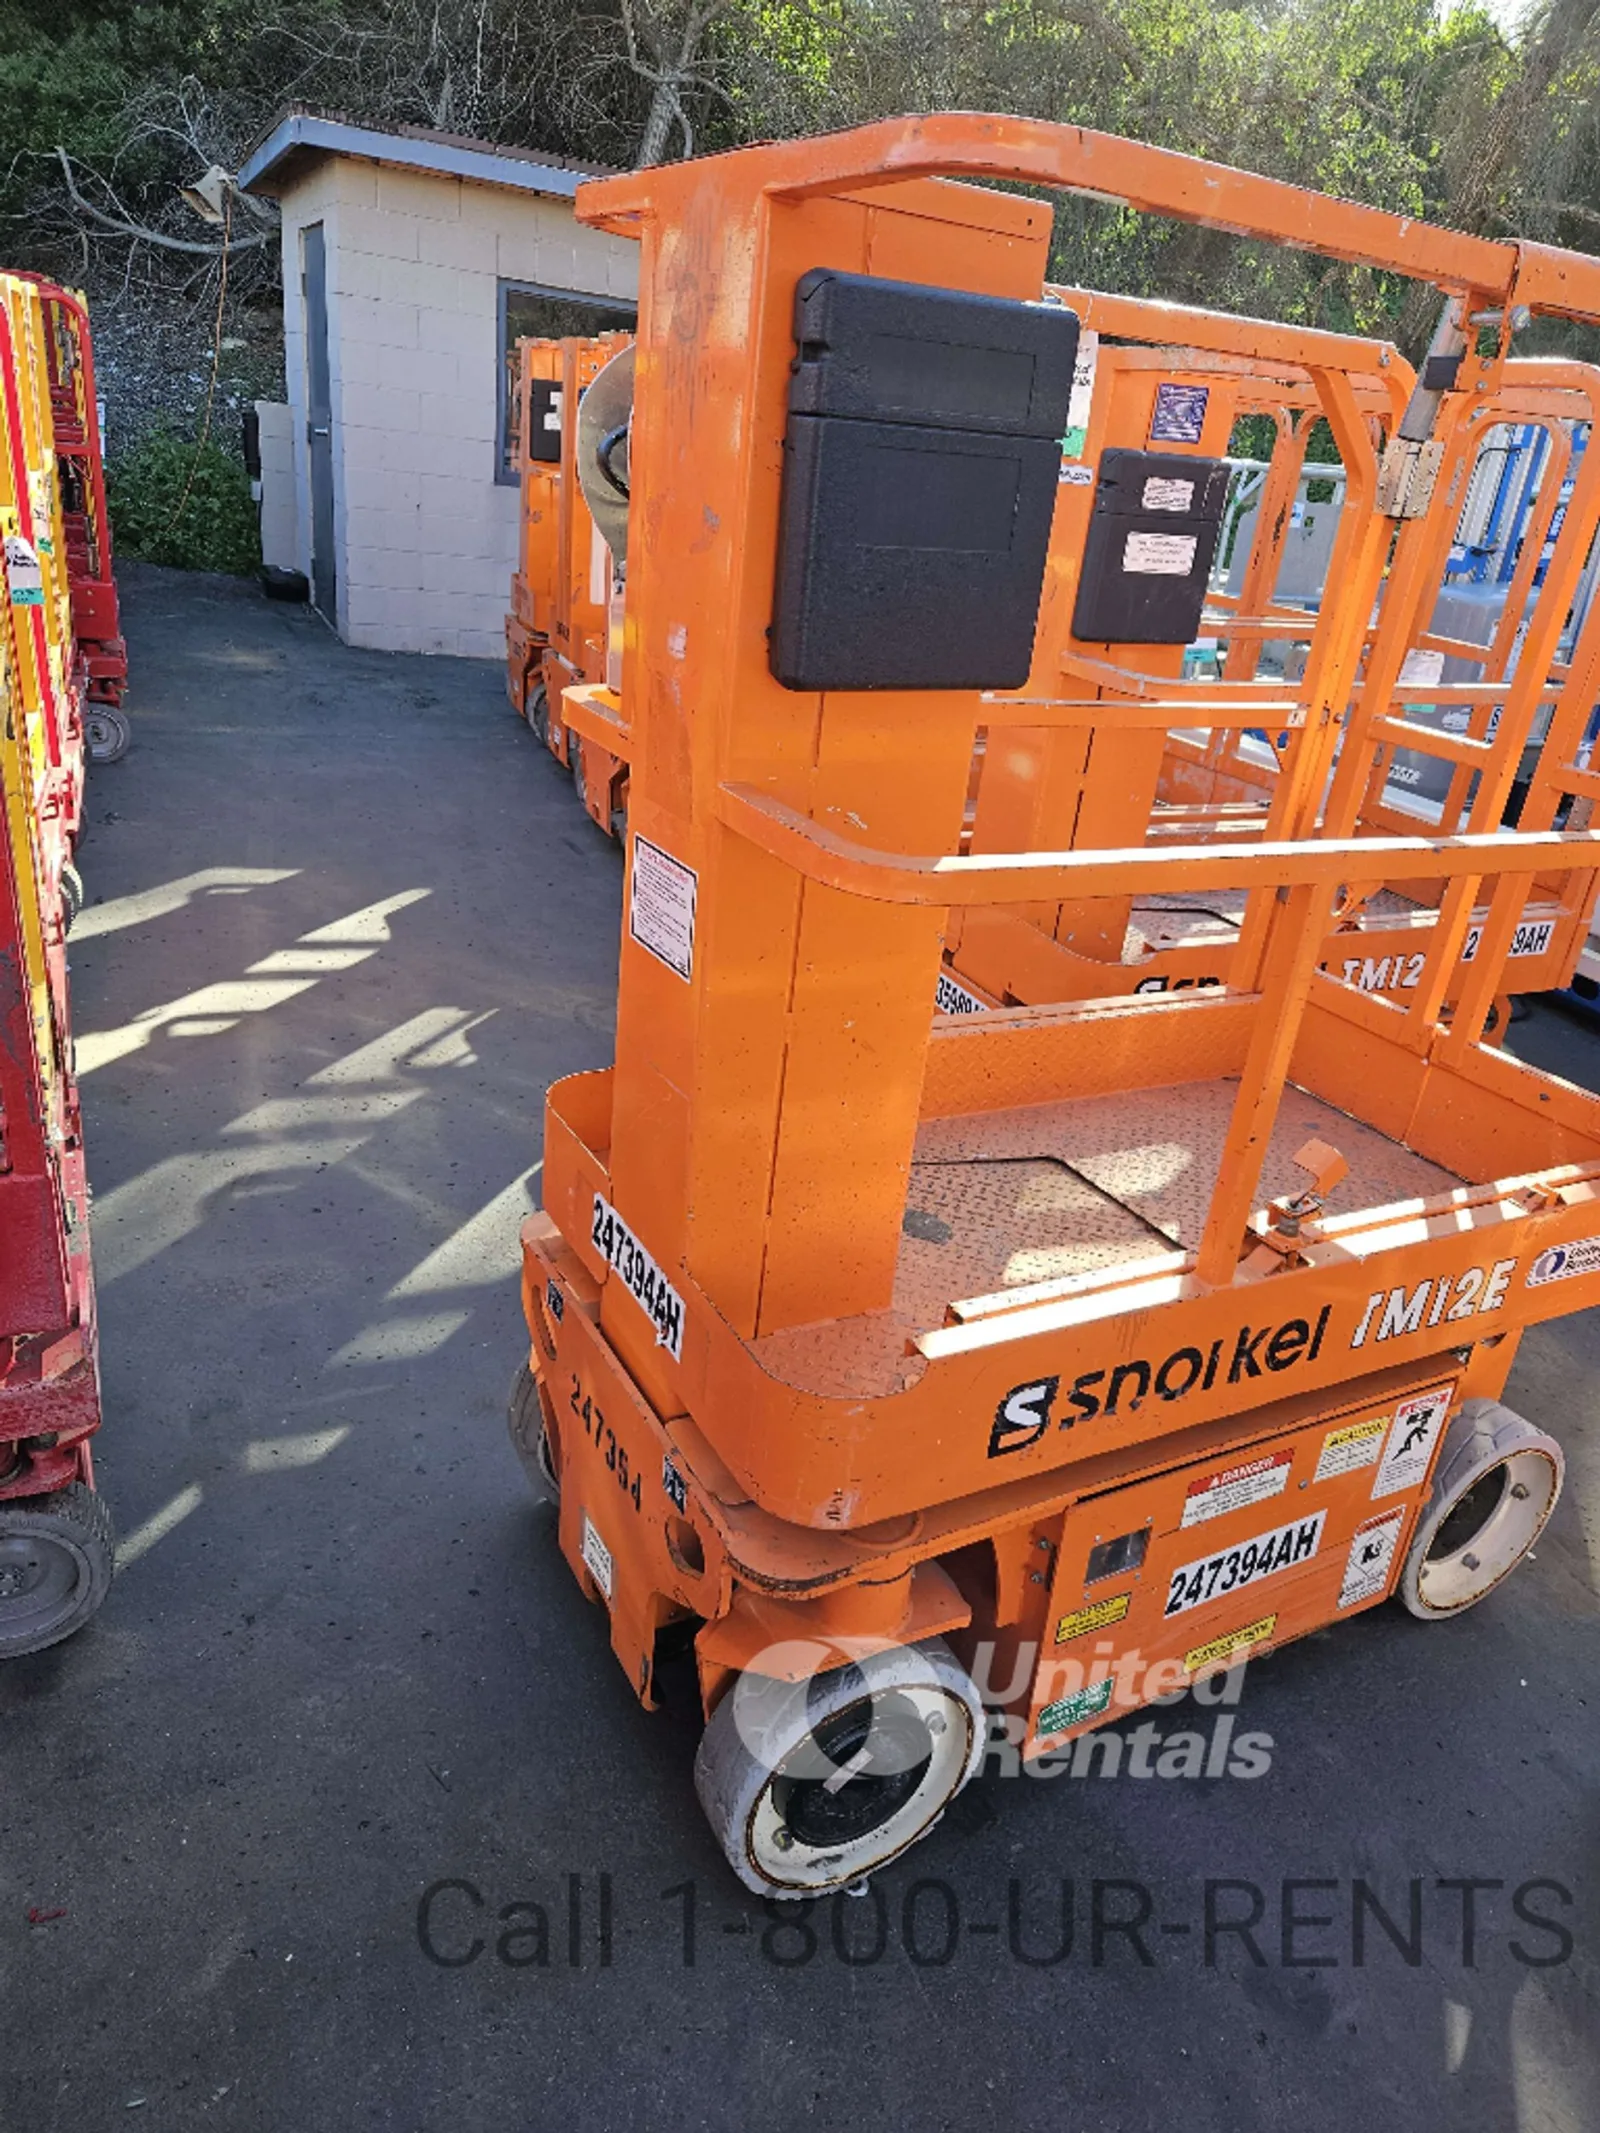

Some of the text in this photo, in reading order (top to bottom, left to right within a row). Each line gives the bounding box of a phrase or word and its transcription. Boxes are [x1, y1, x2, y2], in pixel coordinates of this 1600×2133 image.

[593, 1199, 681, 1353] 247394AH
[1351, 1256, 1519, 1349] TM12E
[1164, 1518, 1319, 1616] 247394AH
